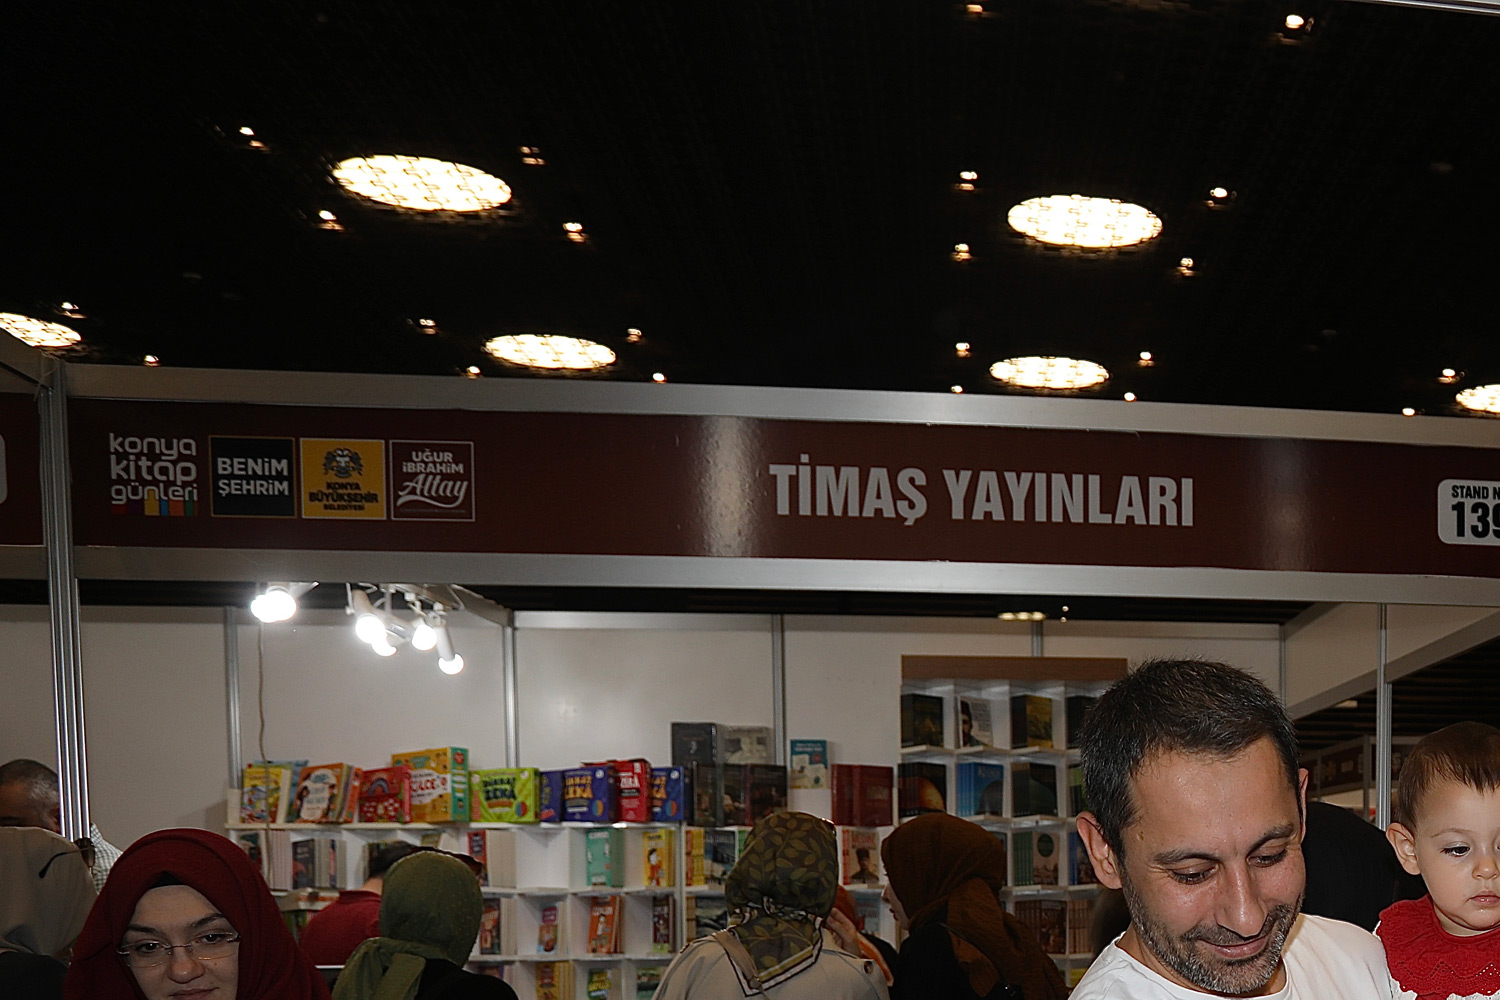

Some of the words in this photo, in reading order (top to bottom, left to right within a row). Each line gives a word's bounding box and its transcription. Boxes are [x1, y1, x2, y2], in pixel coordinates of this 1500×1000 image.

[109, 432, 197, 460] konya
[411, 447, 454, 463] UĞUR
[109, 455, 197, 485] kitap
[110, 483, 199, 505] günleri
[217, 478, 290, 497] ŞEHRİM
[326, 482, 361, 490] KONYA
[396, 474, 470, 508] Altay
[768, 453, 927, 528] TİMAŞ
[942, 469, 1195, 527] YAYINLARI
[1451, 485, 1490, 501] STAND
